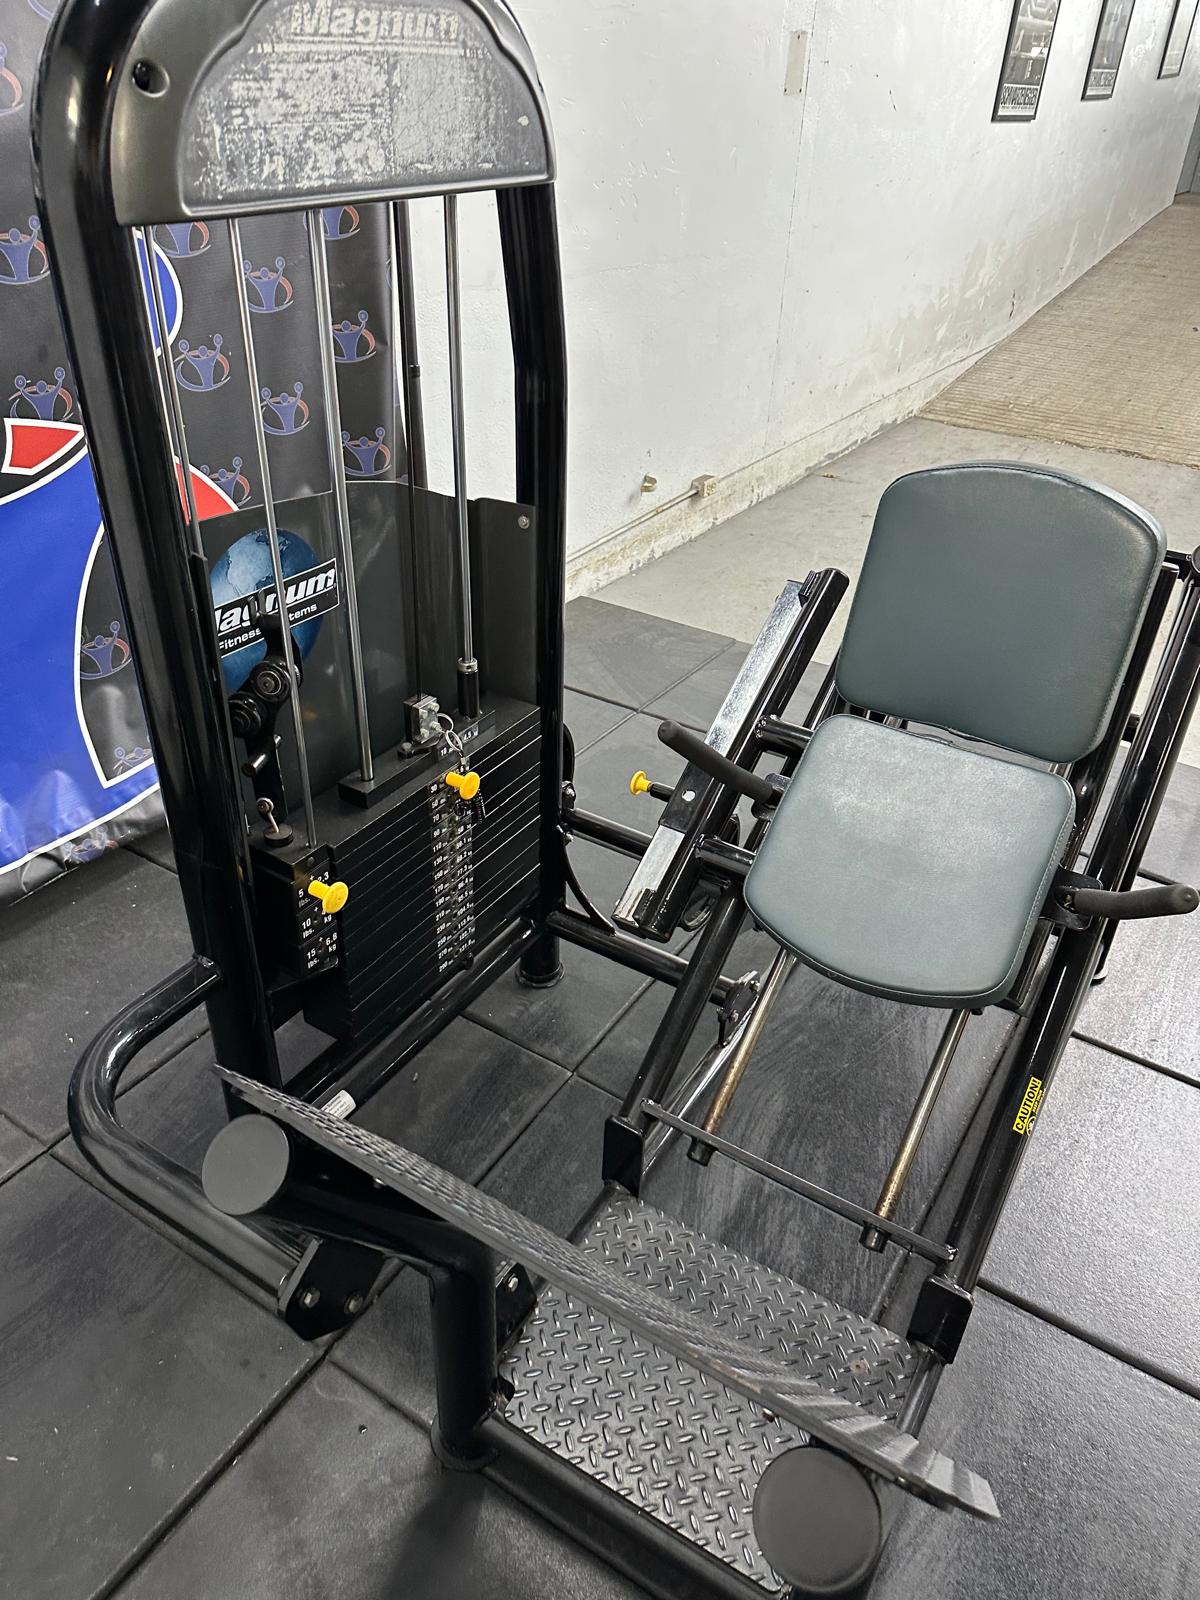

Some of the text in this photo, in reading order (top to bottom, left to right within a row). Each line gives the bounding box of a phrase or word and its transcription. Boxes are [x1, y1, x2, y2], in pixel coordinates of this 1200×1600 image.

[290, 0, 459, 43] Magnum
[214, 568, 336, 632] anum
[219, 603, 318, 650] Fitness tems
[298, 889, 304, 898] 5
[302, 917, 311, 929] 10
[307, 932, 338, 960] 15 6.8
[1015, 1079, 1040, 1131] CAUTION!
